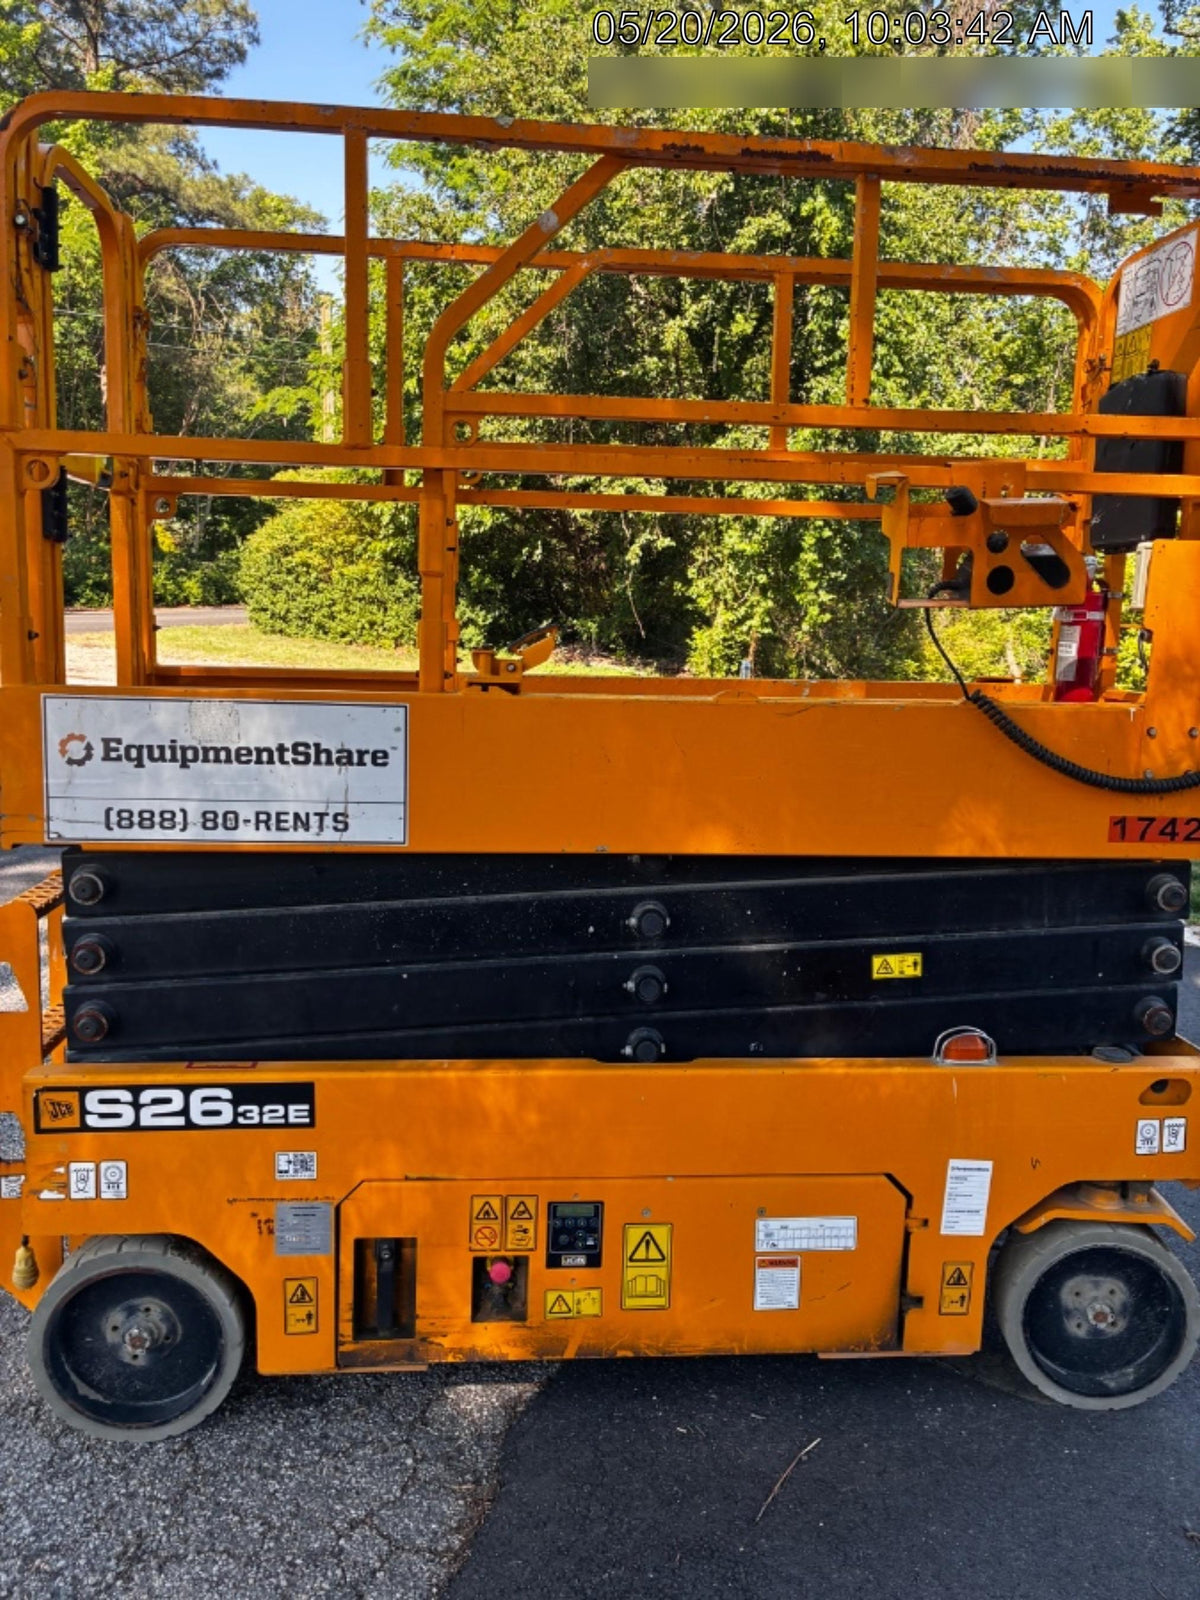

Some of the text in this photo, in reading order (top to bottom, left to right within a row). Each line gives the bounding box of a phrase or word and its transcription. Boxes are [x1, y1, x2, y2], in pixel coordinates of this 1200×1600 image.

[100, 737, 390, 768] EquipmentShare
[104, 807, 350, 833] (888) 80-RENTS
[1112, 816, 1200, 842] 1742
